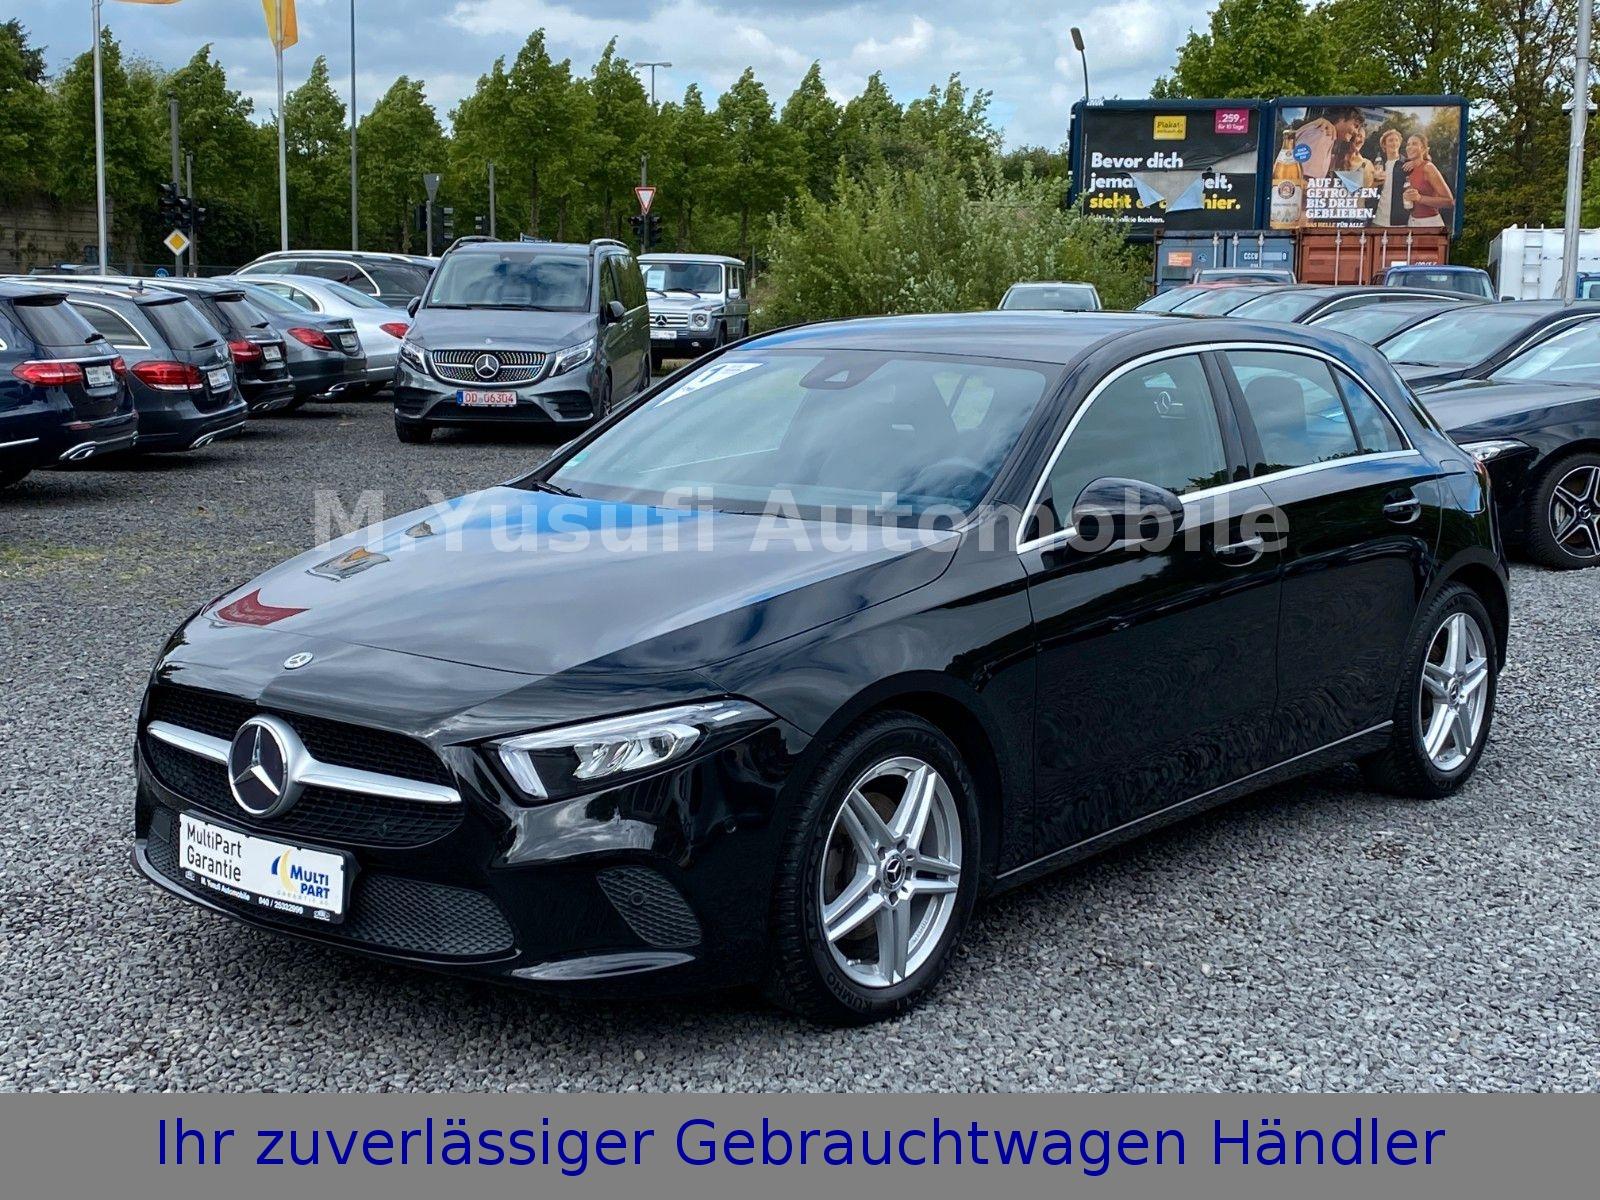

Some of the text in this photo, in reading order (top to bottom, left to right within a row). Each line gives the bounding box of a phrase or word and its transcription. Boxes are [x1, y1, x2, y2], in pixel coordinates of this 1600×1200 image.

[1091, 152, 1184, 168] Bevor dich
[1088, 172, 1137, 193] jema
[1307, 177, 1332, 188] AUF
[1089, 192, 1132, 209] sieht
[1306, 198, 1327, 208] BIS
[1328, 198, 1358, 208] DREI
[1137, 215, 1165, 223] buchen.
[1305, 208, 1376, 219] GEBLIEBEN.
[187, 822, 242, 859] MultiPart
[187, 845, 242, 882] Garantie
[300, 882, 330, 899] PART
[258, 896, 270, 907] 040
